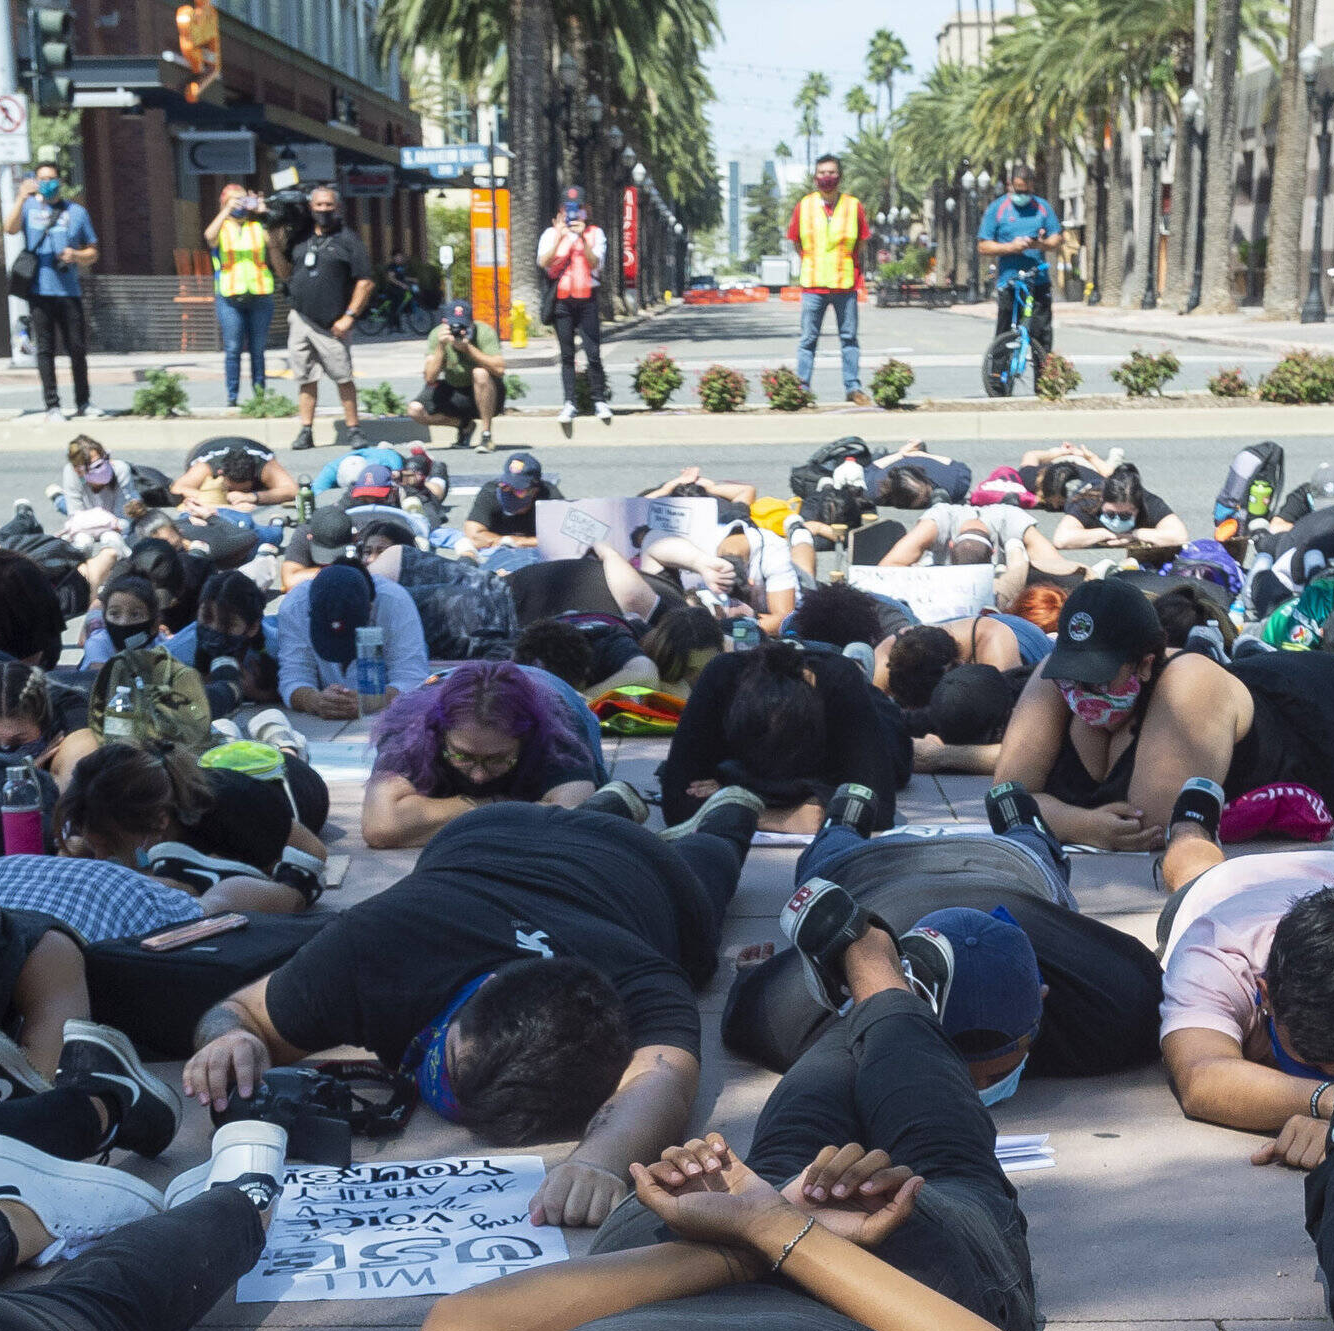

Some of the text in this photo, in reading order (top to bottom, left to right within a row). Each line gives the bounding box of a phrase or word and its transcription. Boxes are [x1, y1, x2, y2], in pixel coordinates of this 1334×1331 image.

[292, 1181, 448, 1201] AMPLIFY
[464, 1179, 517, 1196] to
[280, 1211, 530, 1231] my VOICE
[305, 1266, 436, 1291] WILL
